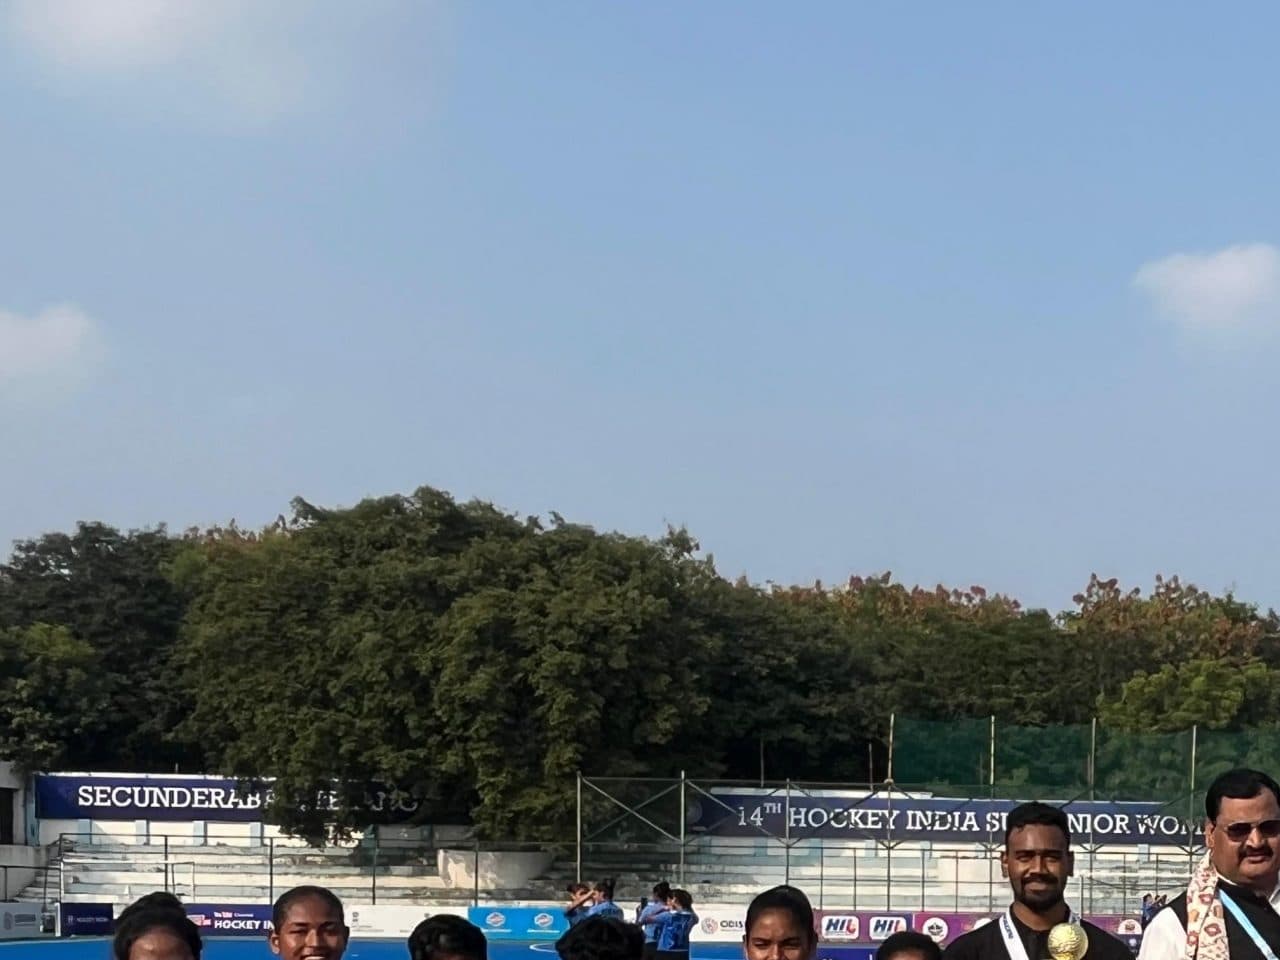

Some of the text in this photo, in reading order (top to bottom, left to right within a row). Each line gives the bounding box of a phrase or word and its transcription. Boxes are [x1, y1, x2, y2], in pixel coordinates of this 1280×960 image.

[789, 808, 900, 830] HOCKEY
[905, 809, 979, 832] INDIA
[214, 920, 260, 930] HOCKEY
